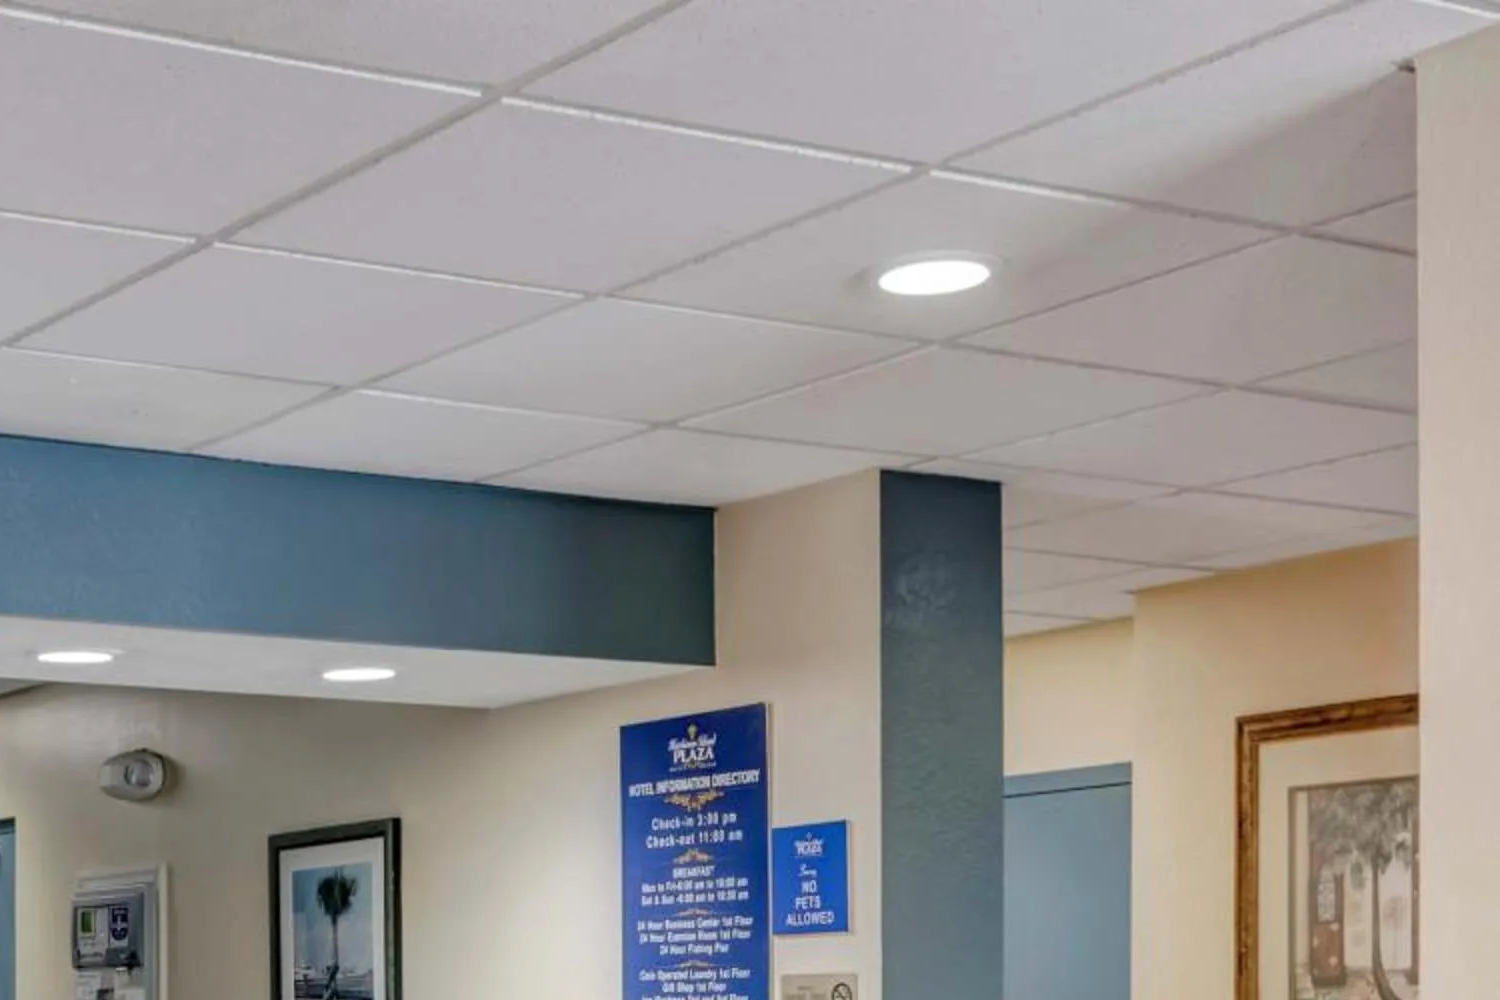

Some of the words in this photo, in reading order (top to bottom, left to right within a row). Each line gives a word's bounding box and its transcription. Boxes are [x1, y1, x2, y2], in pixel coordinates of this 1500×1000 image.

[673, 746, 714, 764] PLAZA
[628, 782, 654, 797] HOTEL
[655, 775, 711, 794] INFORMATION
[712, 768, 760, 787] DIRECTORY
[651, 815, 695, 830] Check-in
[645, 834, 695, 848] Check-out
[802, 880, 817, 893] NO
[795, 895, 821, 910] PETS
[786, 911, 835, 927] ALLOWED
